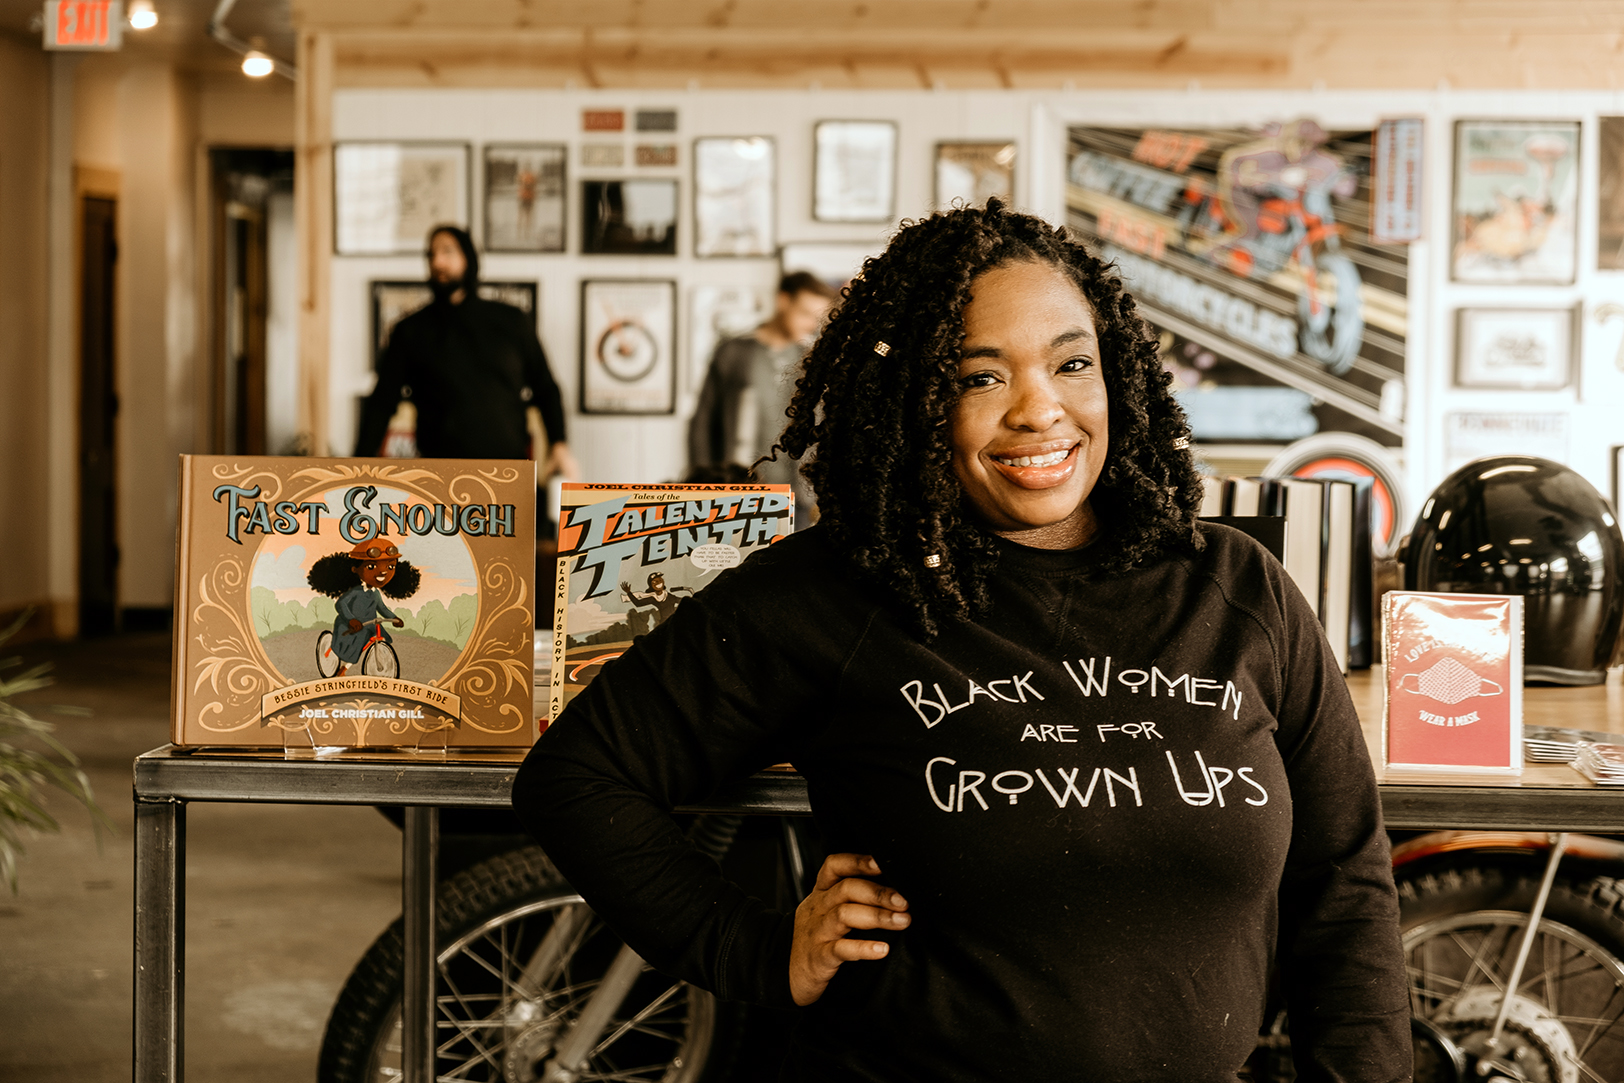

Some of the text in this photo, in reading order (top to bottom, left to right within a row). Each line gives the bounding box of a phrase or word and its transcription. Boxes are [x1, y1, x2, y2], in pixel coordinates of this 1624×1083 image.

[56, 0, 112, 45] EXIT
[212, 484, 517, 546] FAST ENOUGH
[633, 493, 681, 502] Tales of the
[568, 493, 790, 552] TALENTED
[578, 517, 779, 597] TENTH
[557, 560, 567, 599] BLACK
[554, 608, 565, 663] HISTORY
[1404, 641, 1430, 663] LOVE
[274, 680, 448, 705] BESSIE STRINGFIELD'S FIRST RIDE
[552, 672, 561, 687] IN
[900, 656, 1243, 729] BLACK WOMEN
[299, 709, 424, 719] JOEL CHRISTIAN GILL
[1020, 721, 1164, 743] ARE FOR
[1419, 710, 1481, 727] WEAR A MASK
[925, 750, 1268, 812] GROWN UPS
